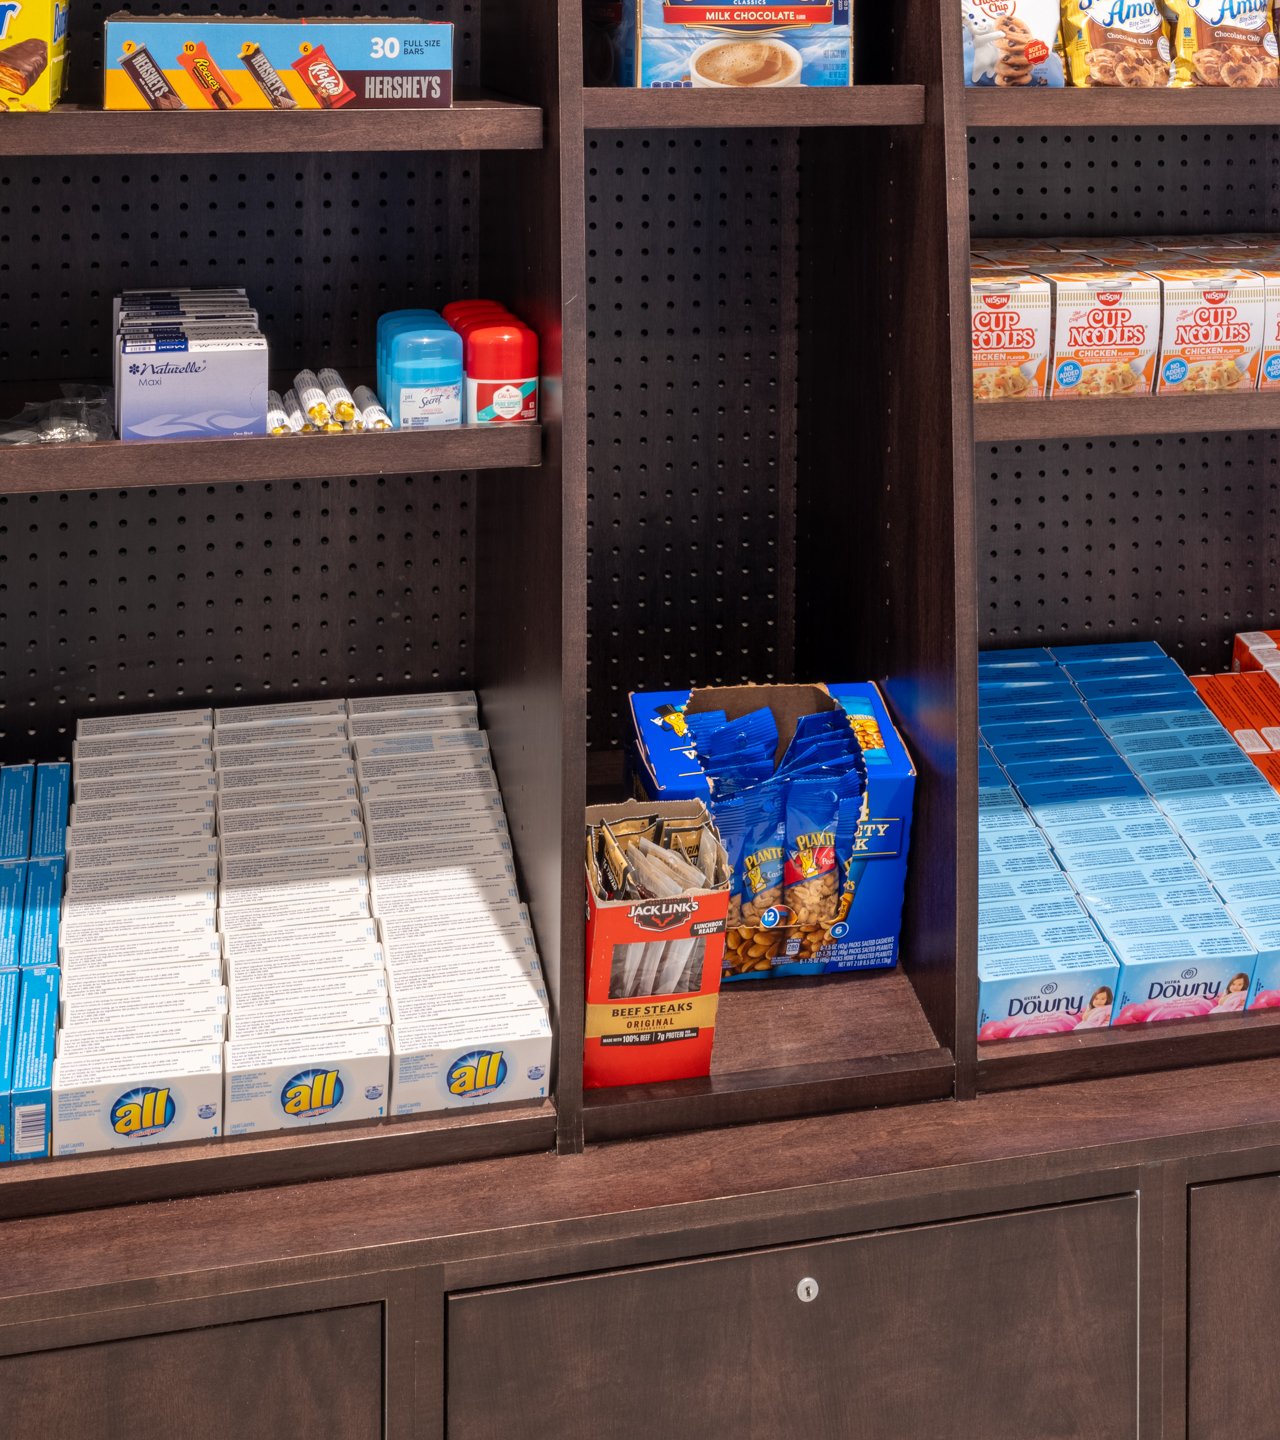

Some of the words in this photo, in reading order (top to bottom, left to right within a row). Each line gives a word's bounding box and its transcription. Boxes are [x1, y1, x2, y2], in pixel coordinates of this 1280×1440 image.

[989, 2, 1009, 12] Chip
[705, 12, 732, 20] MILK
[733, 11, 795, 20] CHOCOLATE
[1107, 32, 1137, 43] Chocolate
[1138, 38, 1153, 46] Chip
[370, 37, 400, 58] 30
[132, 53, 169, 98] HERSHEY'S
[193, 58, 220, 90] Reese's
[250, 53, 287, 96] HERSHEY'S
[365, 76, 441, 99] HERSHEY'S
[1087, 309, 1131, 328] CUP
[1068, 325, 1145, 346] NOODLES
[140, 362, 206, 375] Naturelle
[1060, 370, 1079, 378] ADDED
[139, 377, 162, 386] Maxi
[419, 394, 443, 408] Secret
[628, 906, 660, 917] JACK
[662, 902, 698, 914] LINK'S
[764, 912, 774, 921] 12
[694, 921, 723, 930] LUNCHBOX
[1148, 980, 1220, 999] Downy
[612, 1007, 642, 1017] BEEF
[645, 1002, 693, 1015] STEAKS
[626, 1018, 674, 1028] ORIGINAL
[447, 1051, 503, 1092] all
[280, 1070, 339, 1115] all
[115, 1088, 170, 1133] all
